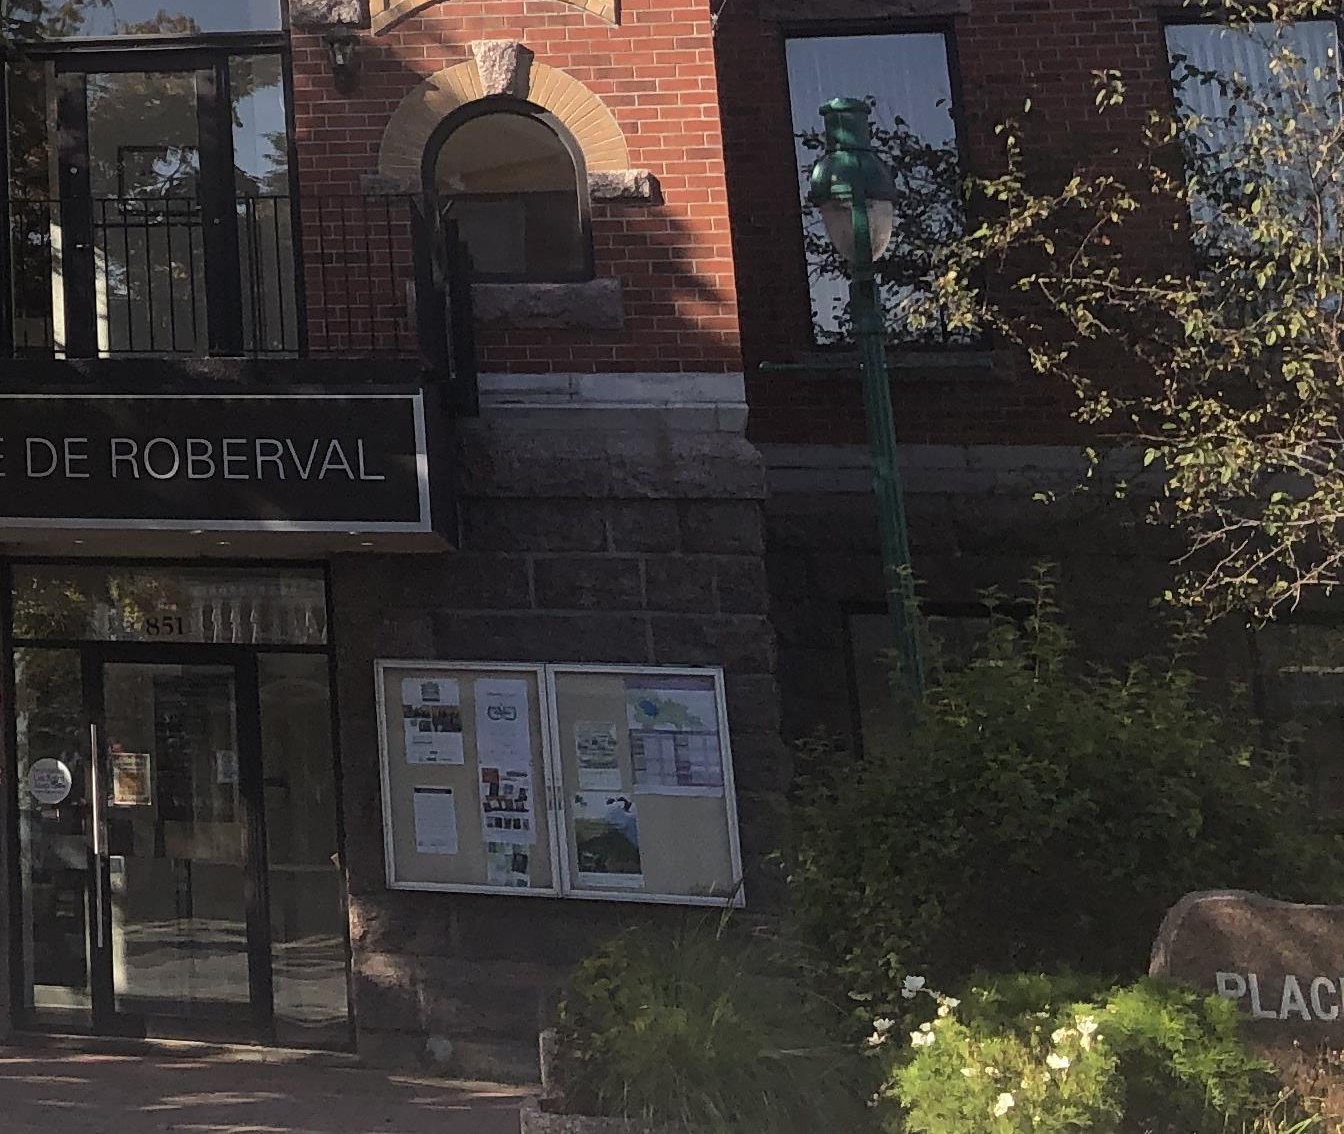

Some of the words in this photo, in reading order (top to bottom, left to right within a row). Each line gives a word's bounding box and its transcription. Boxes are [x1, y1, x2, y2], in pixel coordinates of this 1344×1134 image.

[25, 437, 91, 480] DE
[111, 437, 386, 481] ROBERVAL
[145, 616, 184, 636] 851
